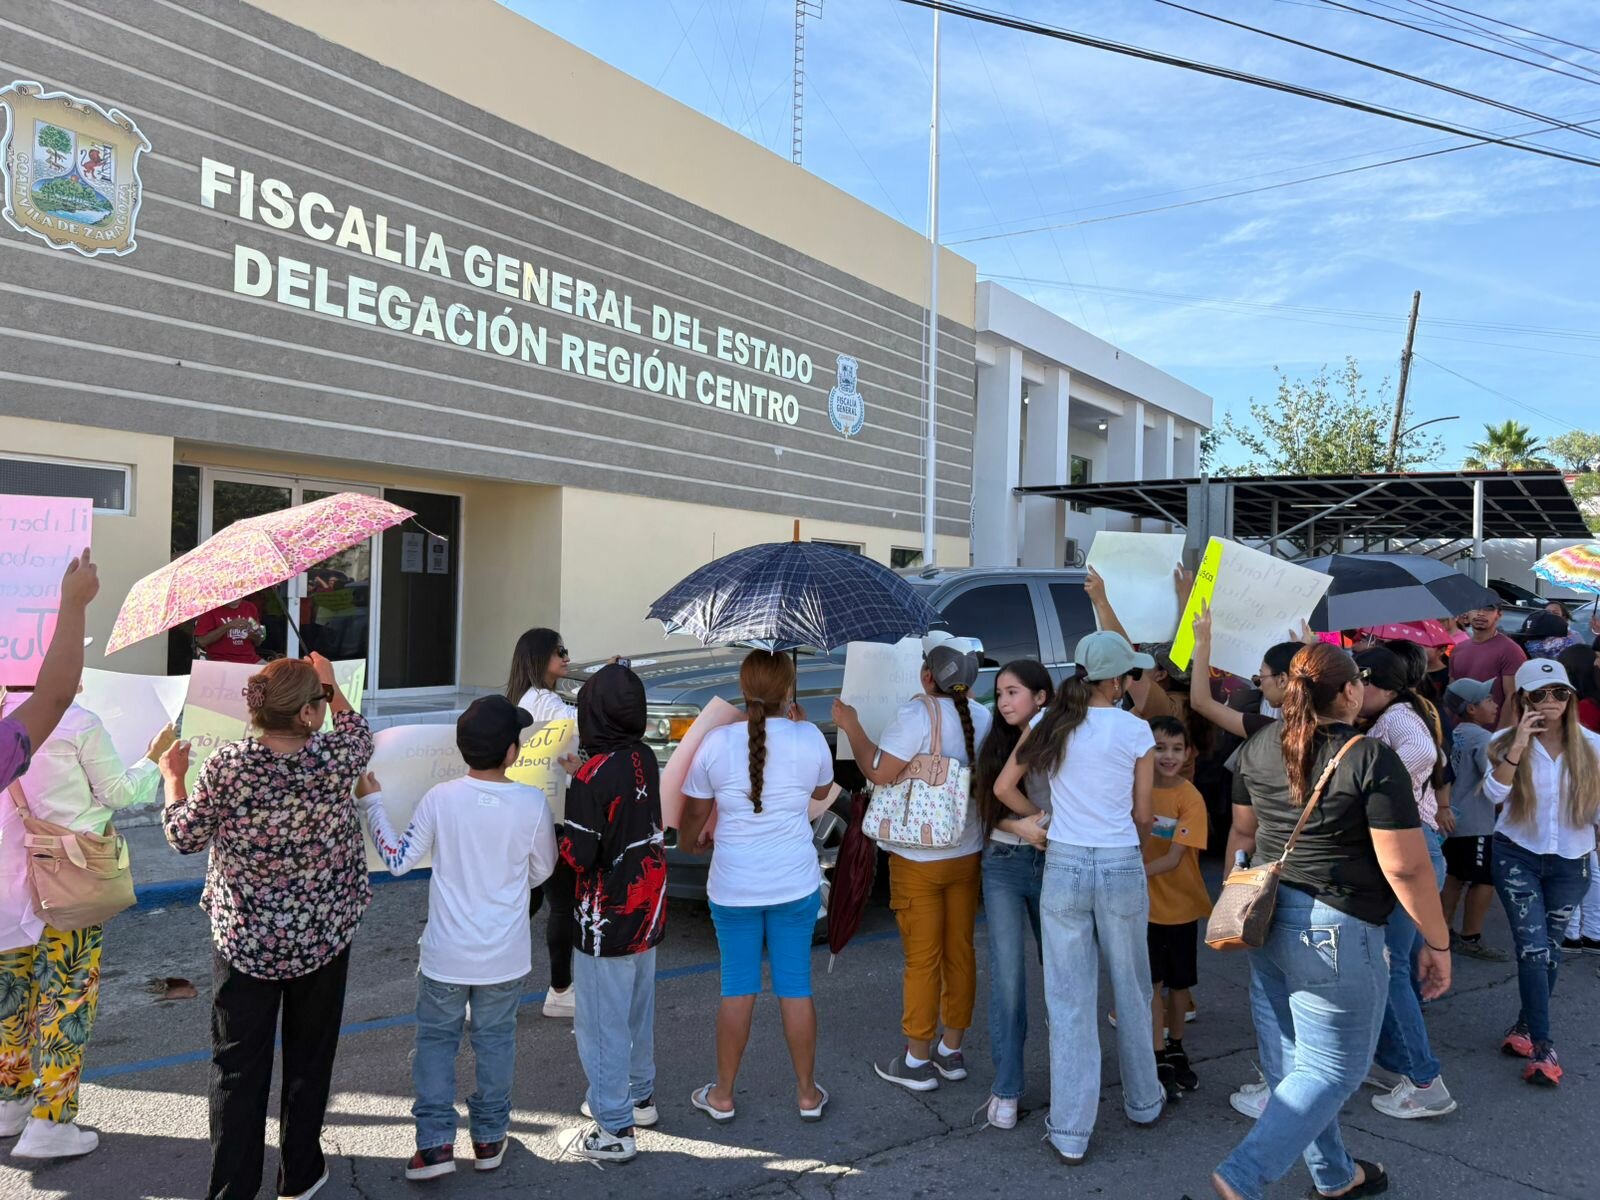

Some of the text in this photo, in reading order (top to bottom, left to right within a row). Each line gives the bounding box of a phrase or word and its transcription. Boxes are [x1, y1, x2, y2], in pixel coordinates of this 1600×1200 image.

[57, 220, 79, 235] DE
[83, 183, 131, 241] ZARAGOZA
[200, 156, 813, 384] FISCALIA GENERAL DEL ESTADO
[233, 244, 800, 426] DELEGACIÓN REGIÓN CENTRO
[836, 403, 858, 417] GENERAL
